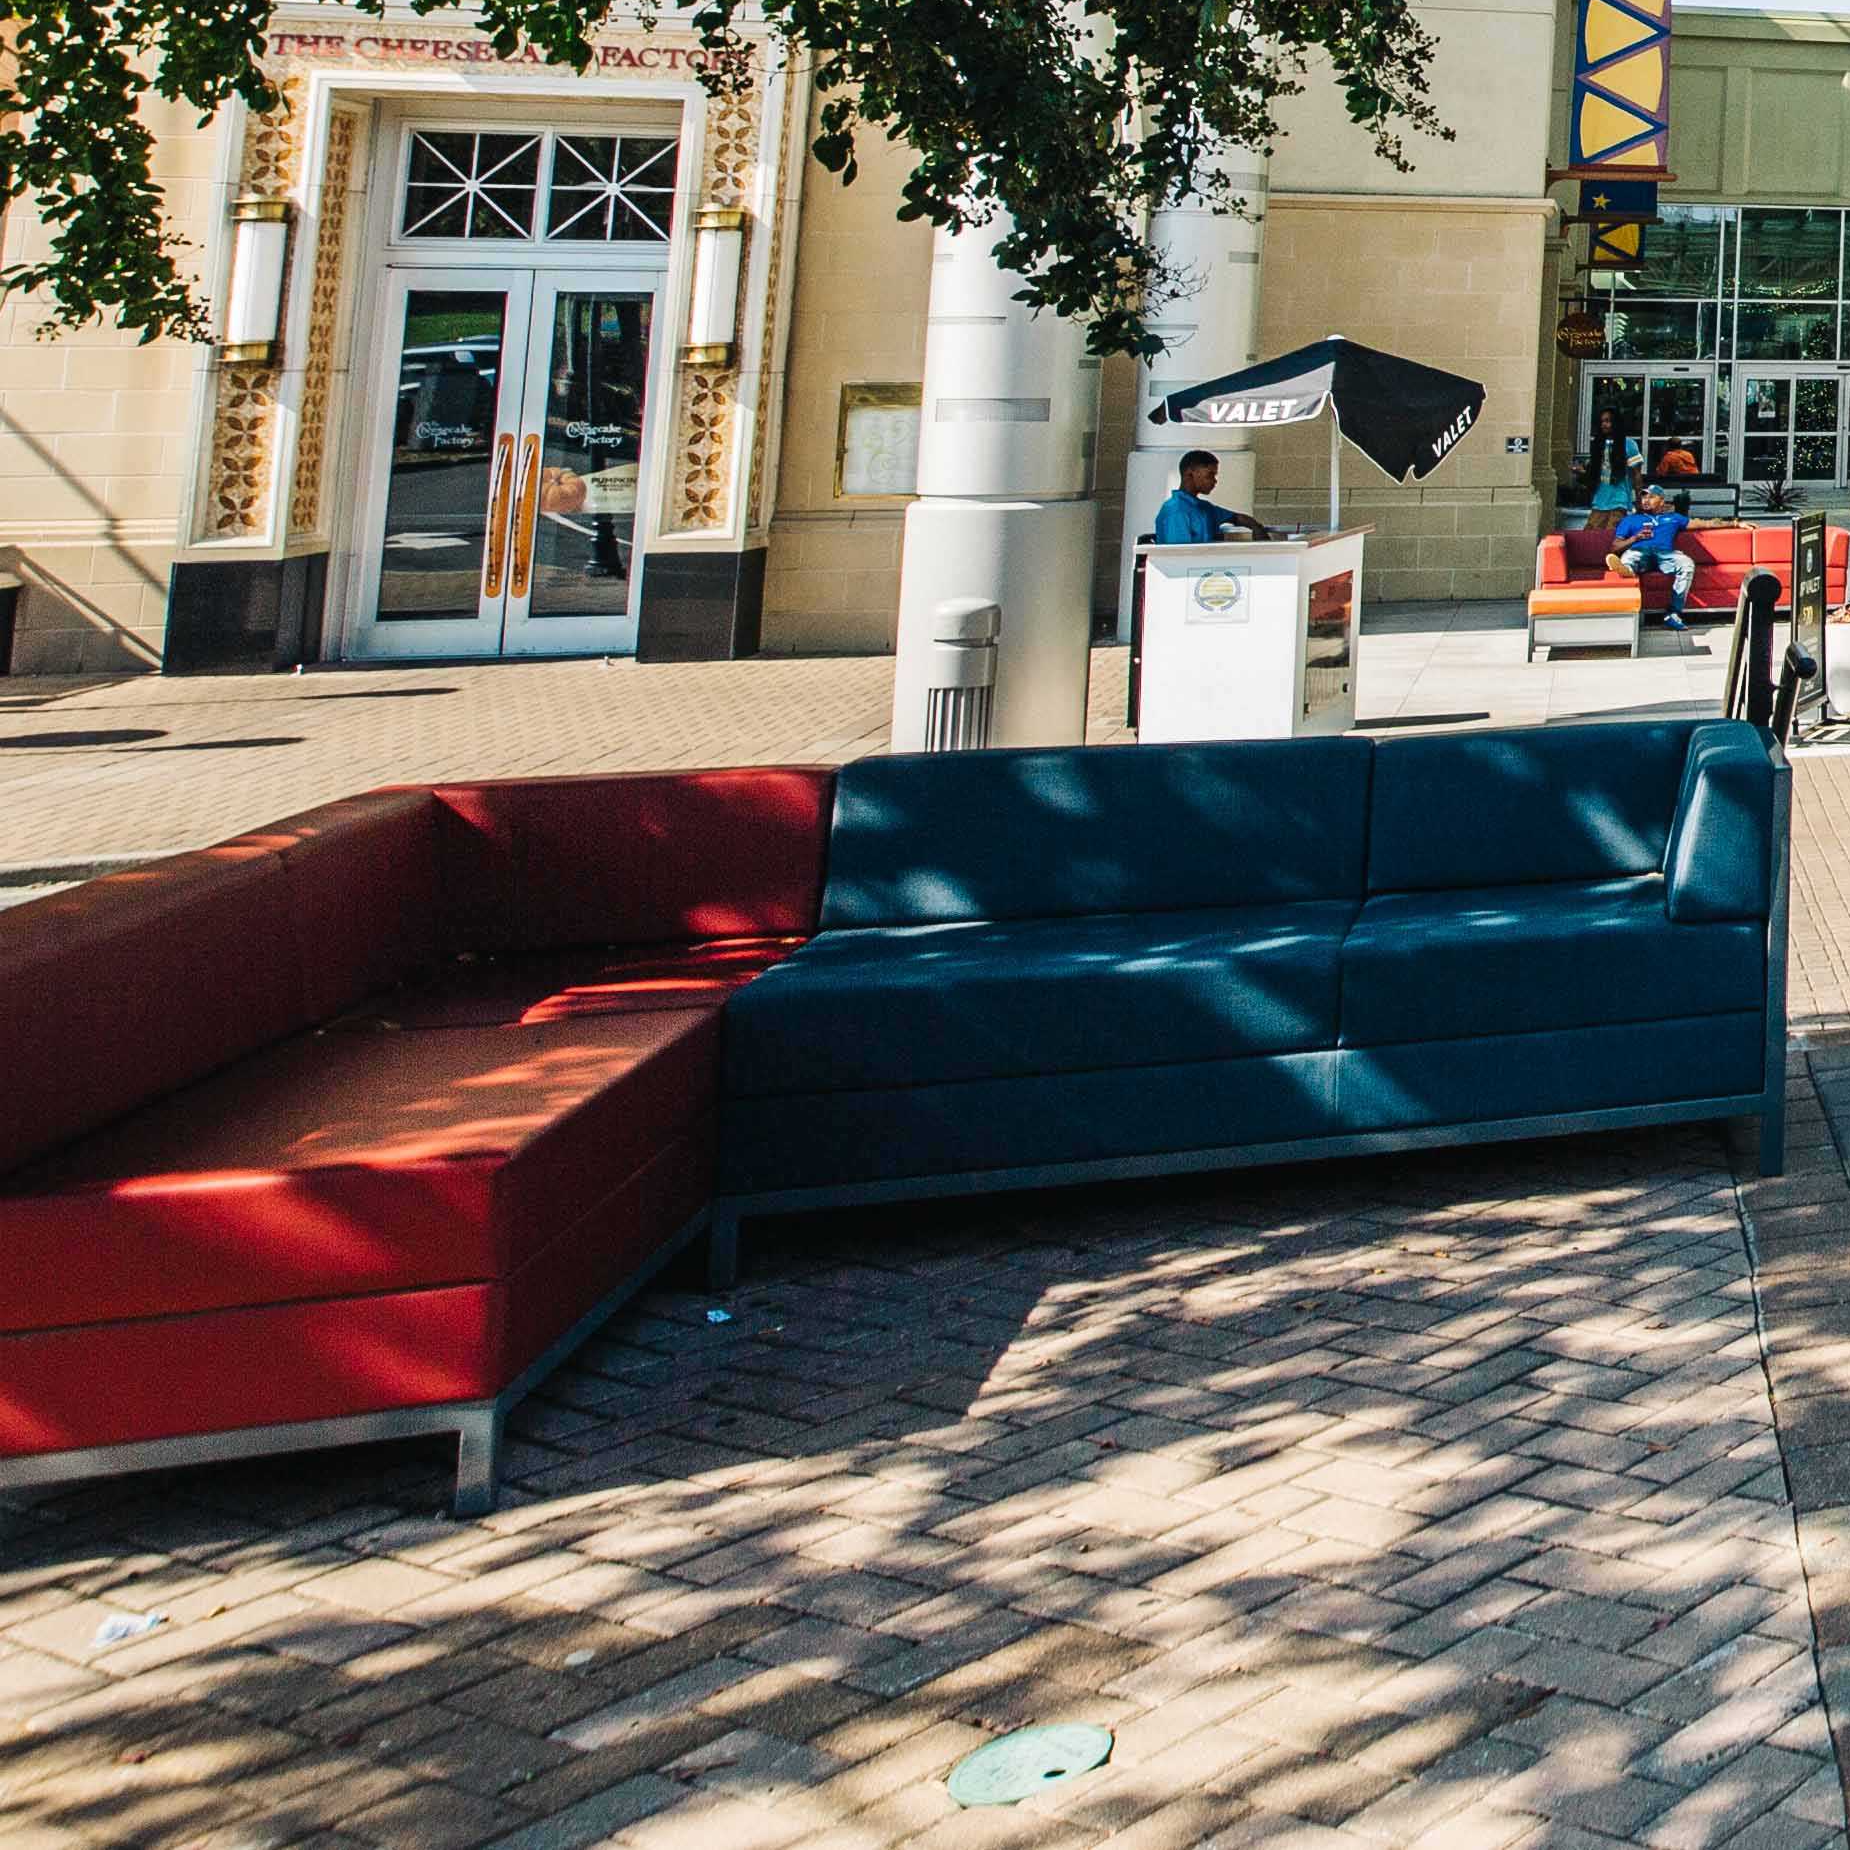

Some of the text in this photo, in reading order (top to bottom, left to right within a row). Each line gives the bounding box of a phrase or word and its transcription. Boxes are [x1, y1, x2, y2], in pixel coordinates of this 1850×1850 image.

[268, 33, 345, 57] THE
[354, 37, 572, 64] CHEESEA
[1208, 399, 1296, 422] VALET
[582, 434, 623, 448] Factory
[1431, 405, 1474, 458] VALET
